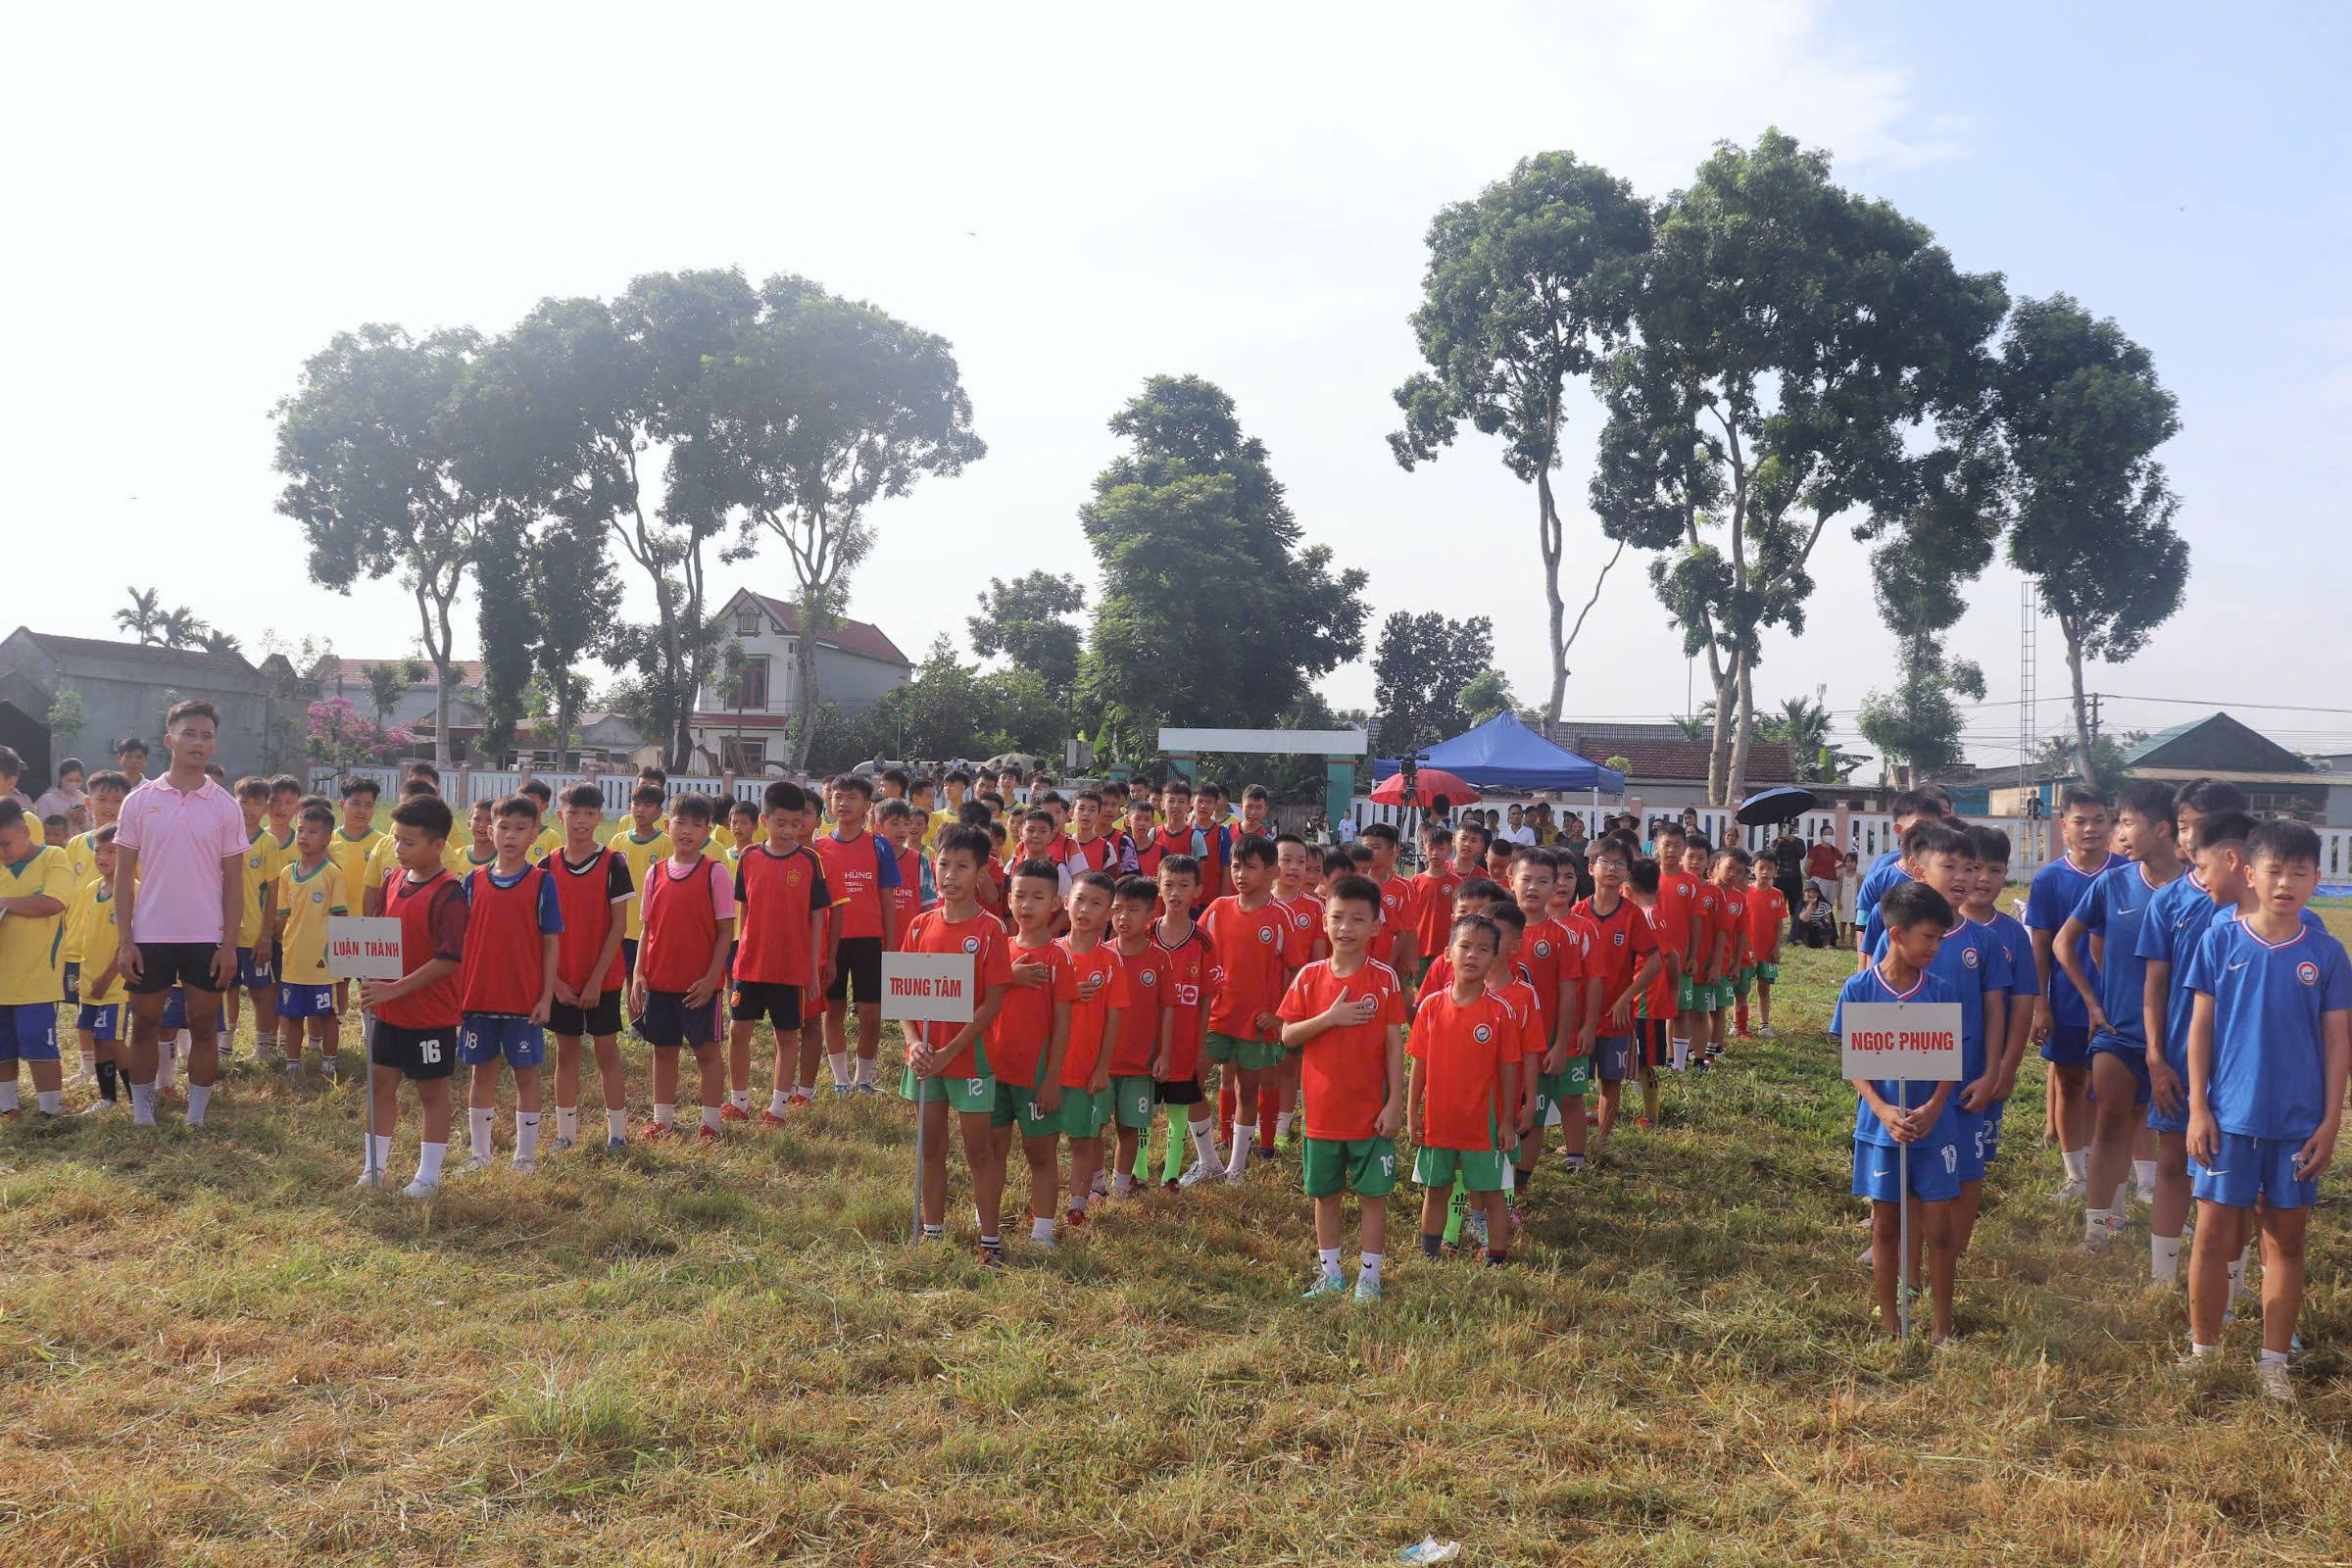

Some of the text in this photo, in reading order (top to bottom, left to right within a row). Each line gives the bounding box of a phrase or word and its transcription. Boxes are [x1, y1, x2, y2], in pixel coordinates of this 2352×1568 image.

[890, 975, 961, 998] TRUNG TÂM
[316, 992, 331, 1009] 29
[465, 1030, 478, 1050] 18
[1851, 1031, 1954, 1055] NGỌC PHỤNG
[419, 1040, 442, 1064] 16
[1138, 1097, 1149, 1113] 8
